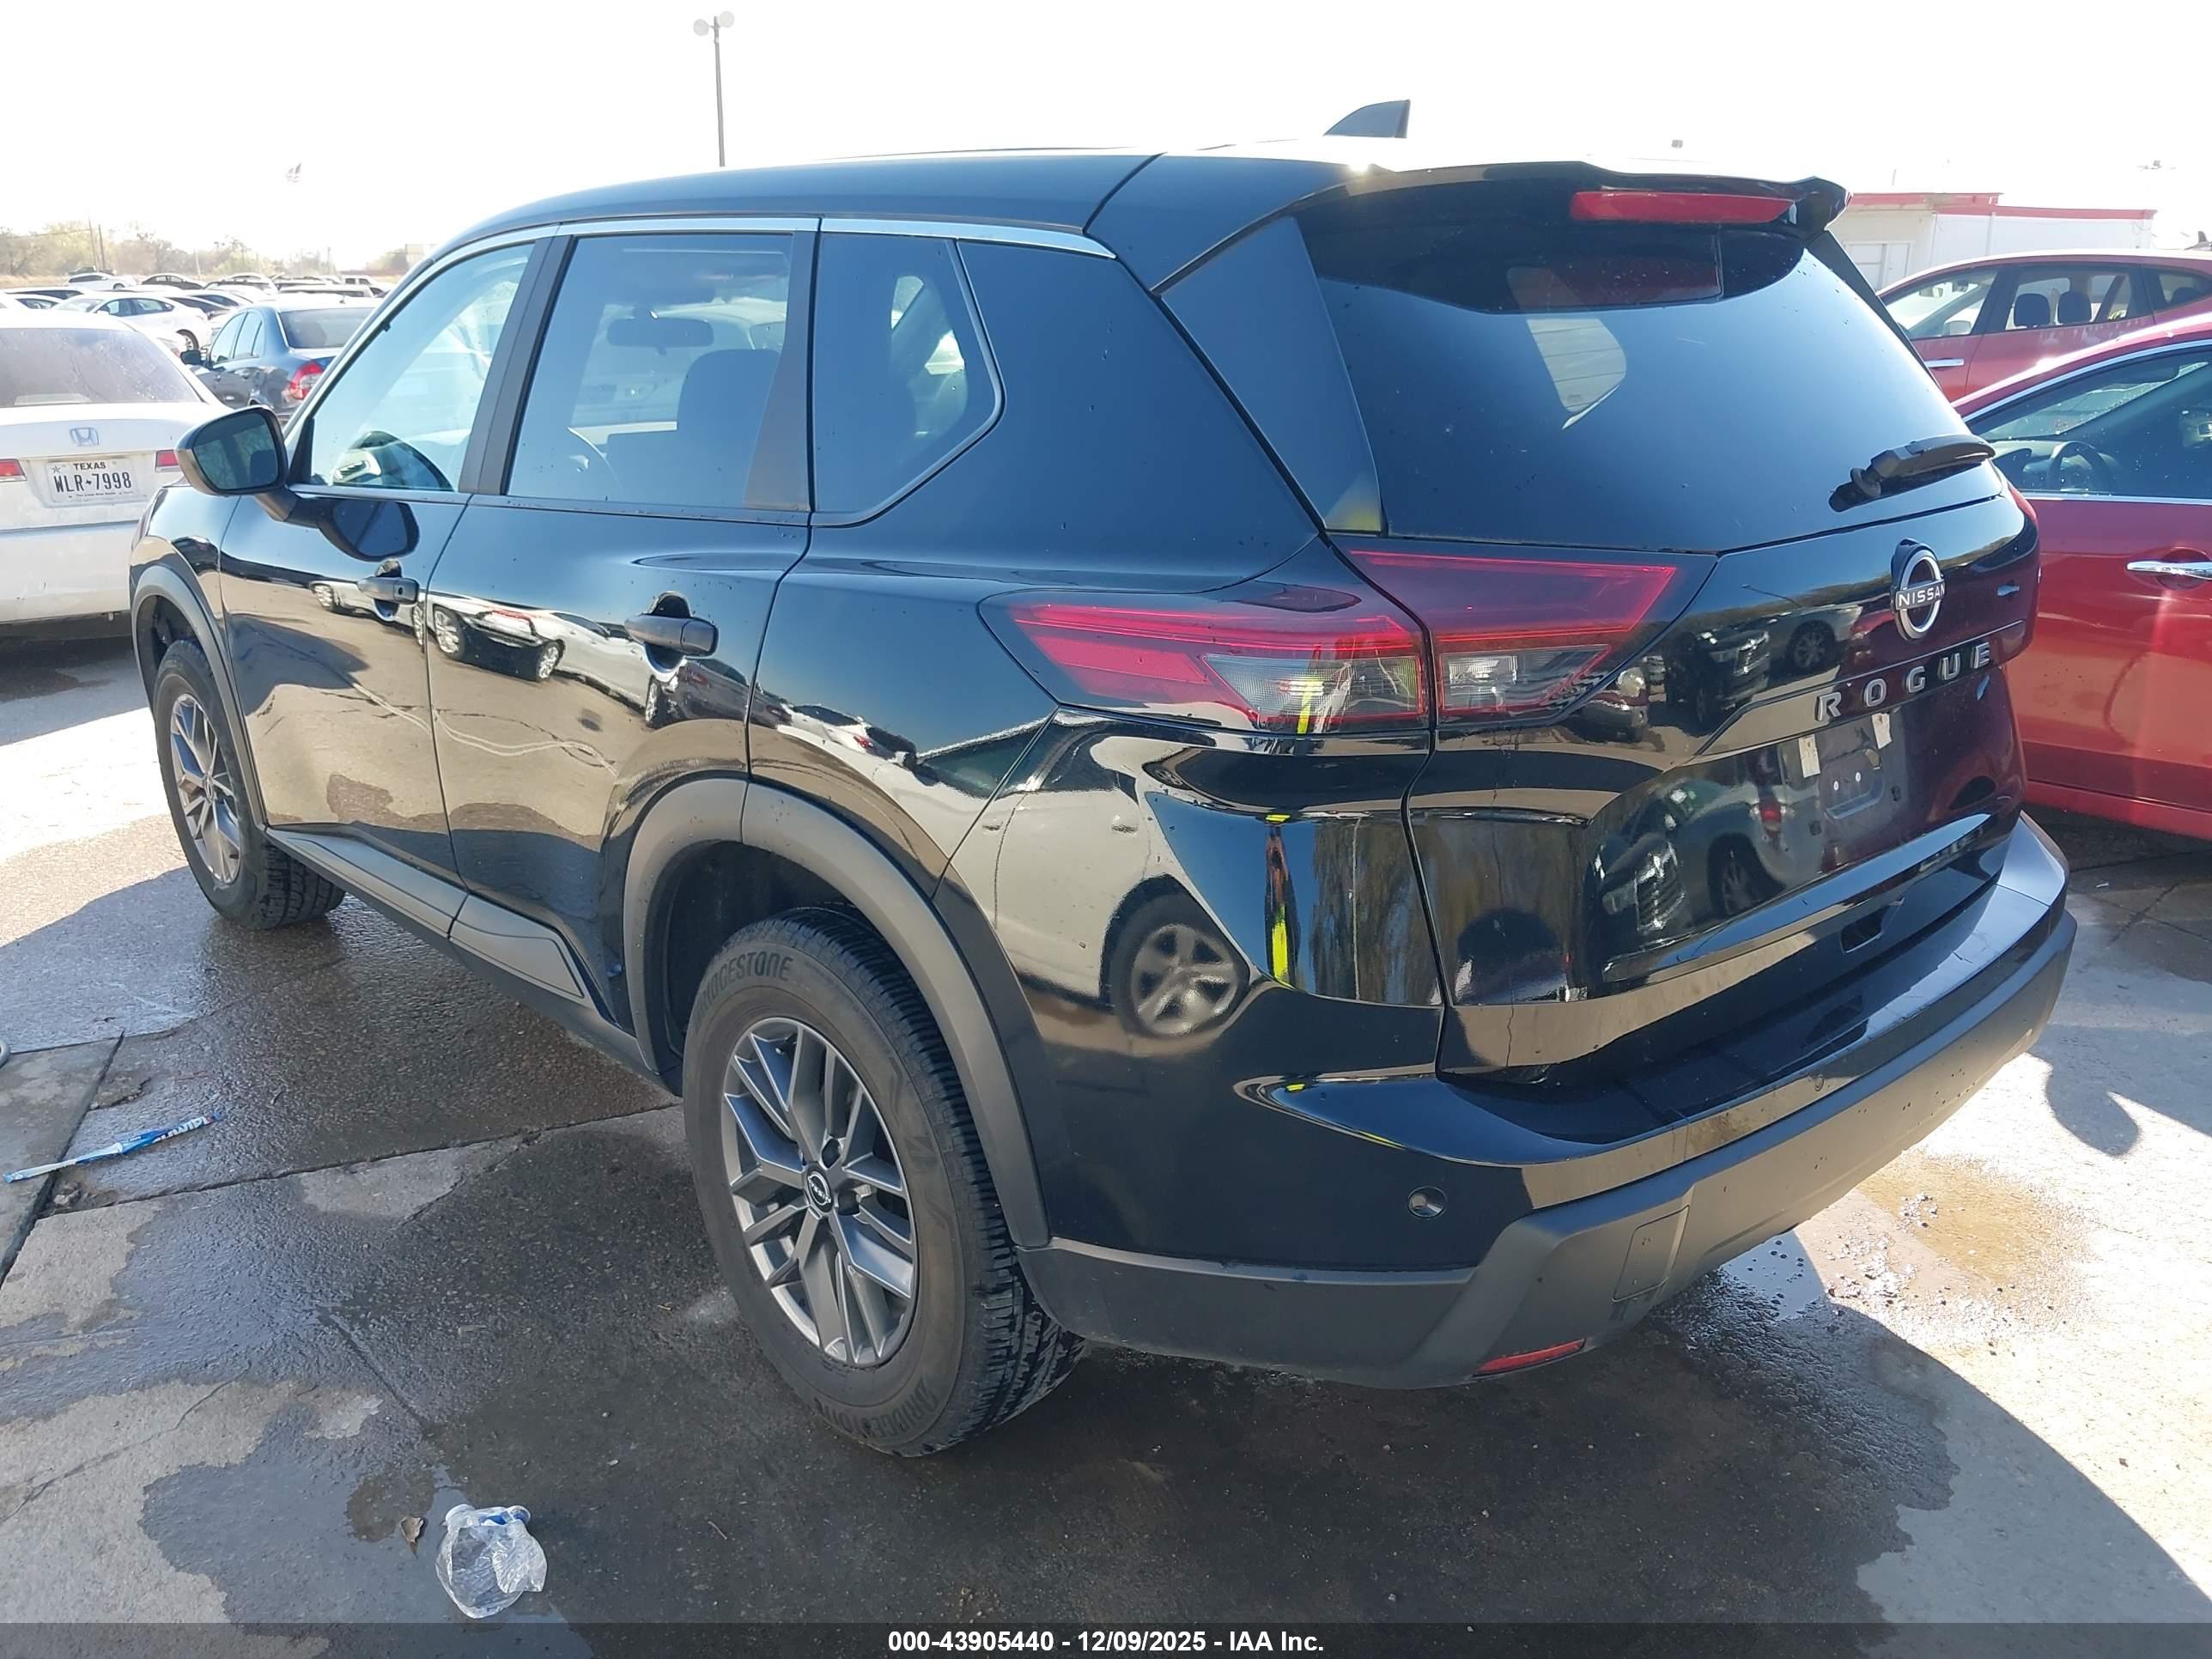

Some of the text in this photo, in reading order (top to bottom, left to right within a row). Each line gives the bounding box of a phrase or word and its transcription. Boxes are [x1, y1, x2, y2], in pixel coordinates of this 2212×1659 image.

[73, 462, 106, 471] TEXAS
[1899, 583, 1945, 607] NISSAN
[1814, 641, 1990, 721] ROGUE
